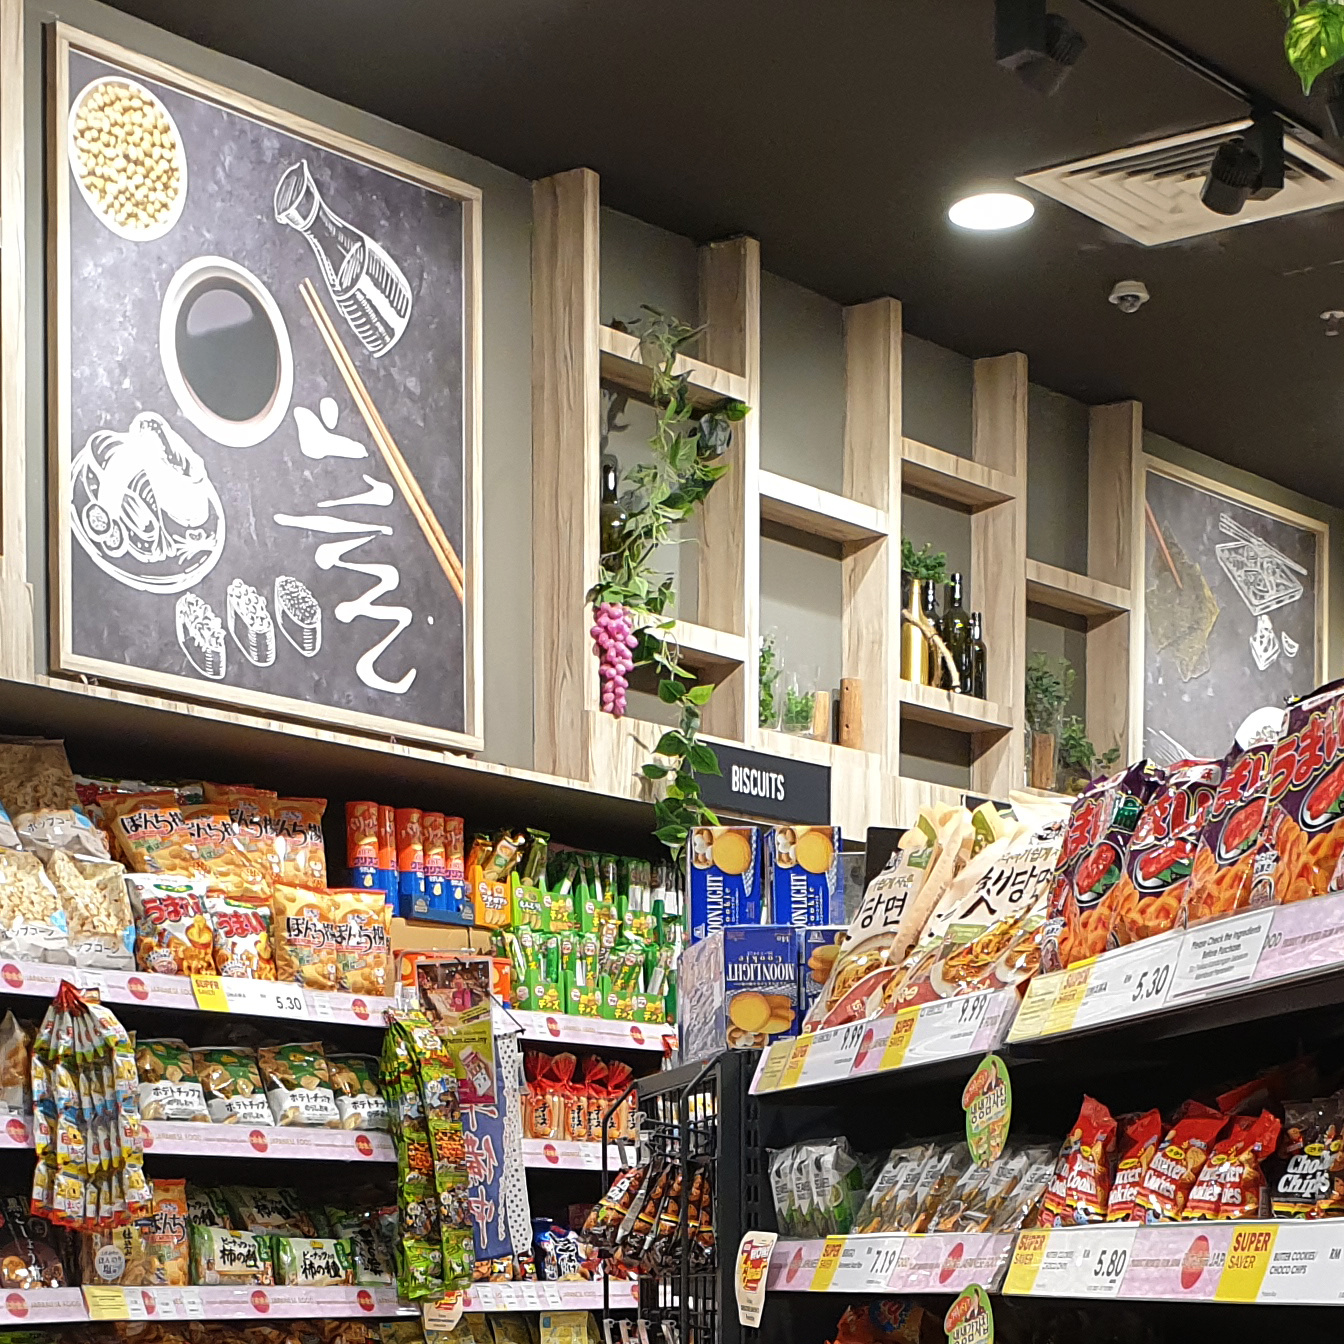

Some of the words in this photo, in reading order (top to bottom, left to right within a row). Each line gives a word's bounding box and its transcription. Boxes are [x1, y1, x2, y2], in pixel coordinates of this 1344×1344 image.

[731, 764, 785, 802] BISCUITS
[726, 963, 796, 982] MOONLIGHT
[1131, 963, 1171, 1002] 5.30
[276, 994, 303, 1012] 5.30
[958, 997, 987, 1025] 9.99
[840, 1025, 864, 1050] 9.99
[1232, 1231, 1272, 1253] SUPER
[868, 1249, 896, 1274] 7.19
[1093, 1248, 1127, 1278] 5.80
[1269, 1263, 1291, 1276] CHOCO
[1291, 1263, 1309, 1276] CHIPS
